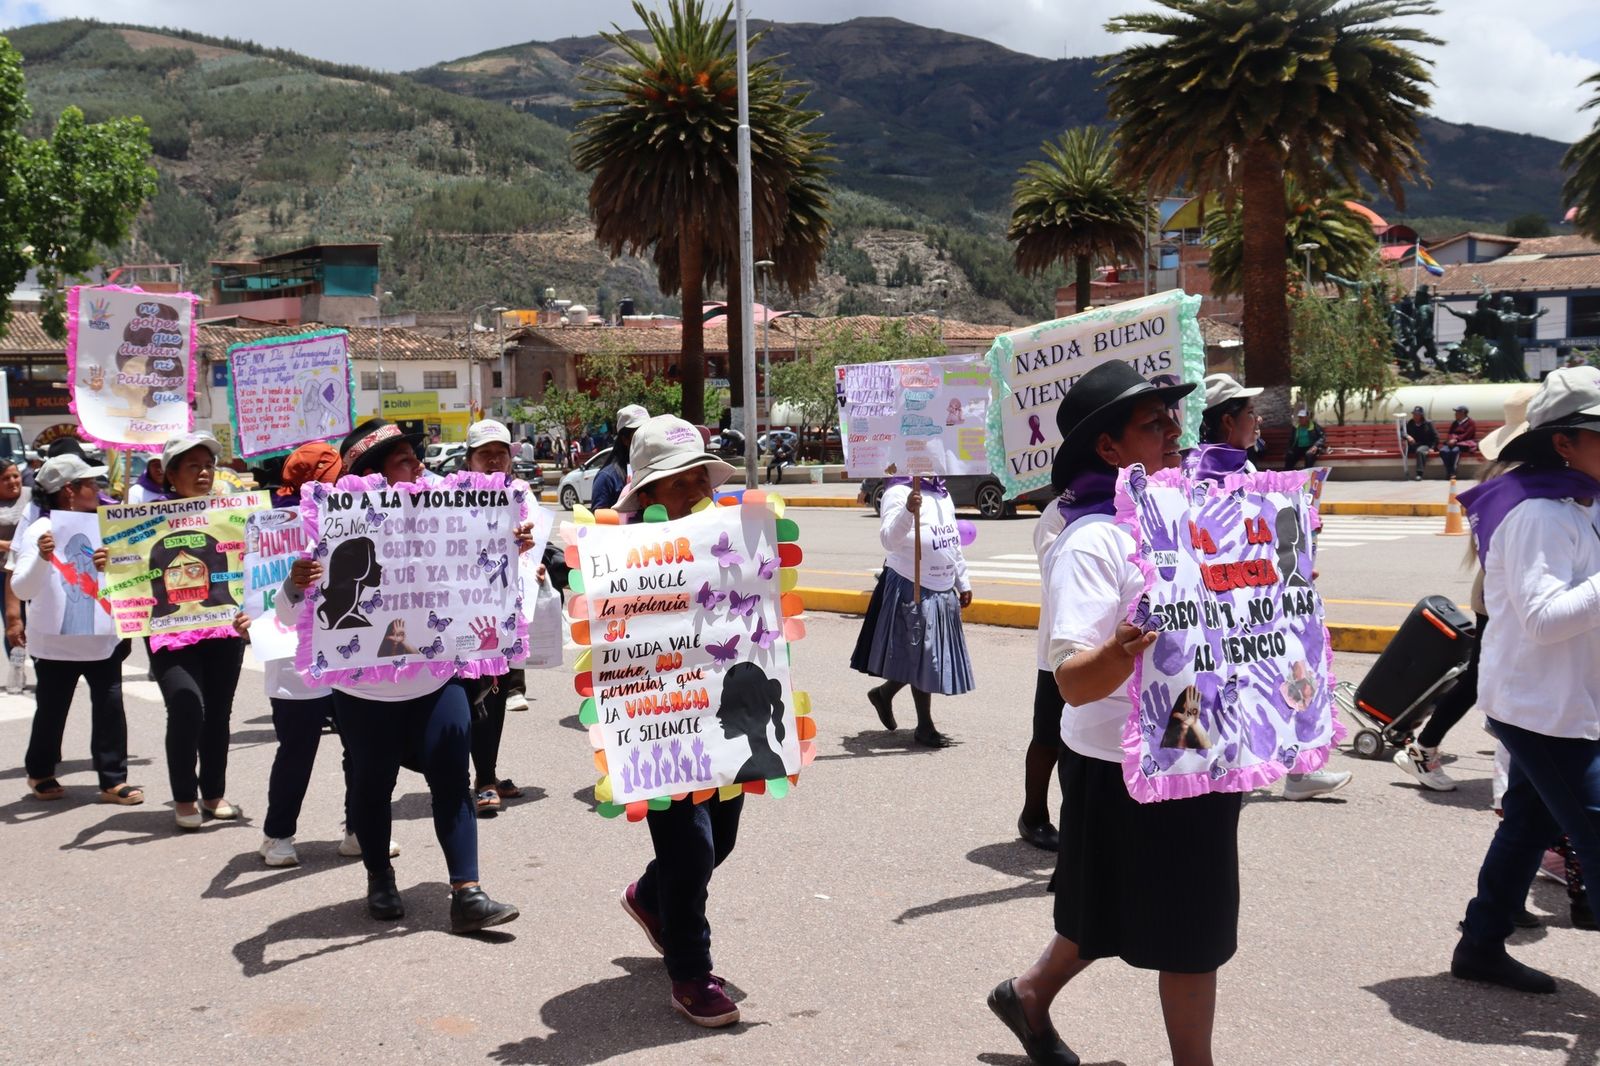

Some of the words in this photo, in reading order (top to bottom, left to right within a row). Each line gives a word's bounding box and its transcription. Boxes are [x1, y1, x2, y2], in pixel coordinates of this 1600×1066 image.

[139, 303, 160, 314] ni
[131, 318, 179, 331] golpes
[152, 333, 181, 345] que
[1015, 340, 1082, 374] NADA
[1093, 316, 1165, 352] BUENO
[120, 344, 179, 357] duelan
[153, 361, 174, 370] ni
[116, 373, 185, 387] Palabras
[153, 393, 183, 404] que
[391, 399, 411, 408] bitel
[130, 420, 183, 431] hieran
[107, 508, 122, 519] NO
[150, 501, 206, 515] MALTRATO
[247, 496, 258, 506] NI
[327, 492, 353, 512] NO
[360, 492, 371, 509] A
[380, 491, 402, 508] LA
[409, 490, 509, 508] VIOLENCIA
[168, 517, 208, 528] VERBAL
[383, 517, 439, 535] SOMOS
[445, 516, 467, 533] EL
[930, 524, 954, 536] Vivas
[1244, 517, 1273, 545] LA
[217, 543, 241, 551] NADIE
[382, 540, 436, 558] GRITO
[446, 539, 468, 556] DE
[476, 538, 507, 555] LAS
[932, 535, 959, 550] Libres
[590, 553, 618, 578] EL
[626, 537, 694, 569] AMOR
[1155, 552, 1164, 566] 25
[135, 570, 161, 585] TONTA
[212, 573, 229, 581] ERES
[426, 565, 449, 582] YA
[456, 564, 481, 581] NO
[610, 577, 628, 593] NO
[637, 570, 687, 590] DUELE
[382, 591, 450, 611] TIENEN
[599, 598, 616, 619] la
[623, 594, 689, 617] violencia
[1204, 600, 1221, 629] EN
[1281, 590, 1315, 618] MAS
[602, 649, 621, 664] TU
[627, 641, 663, 659] VIDA
[669, 634, 701, 650] VALE
[1193, 644, 1215, 671] AL
[655, 652, 683, 673] NO
[600, 675, 667, 705] permitas
[676, 668, 705, 689] que
[604, 707, 621, 724] LA
[625, 687, 710, 719] VIOLENCIA
[1187, 708, 1198, 717] NO
[617, 728, 632, 746] TE
[639, 716, 702, 741] SILENCIE
